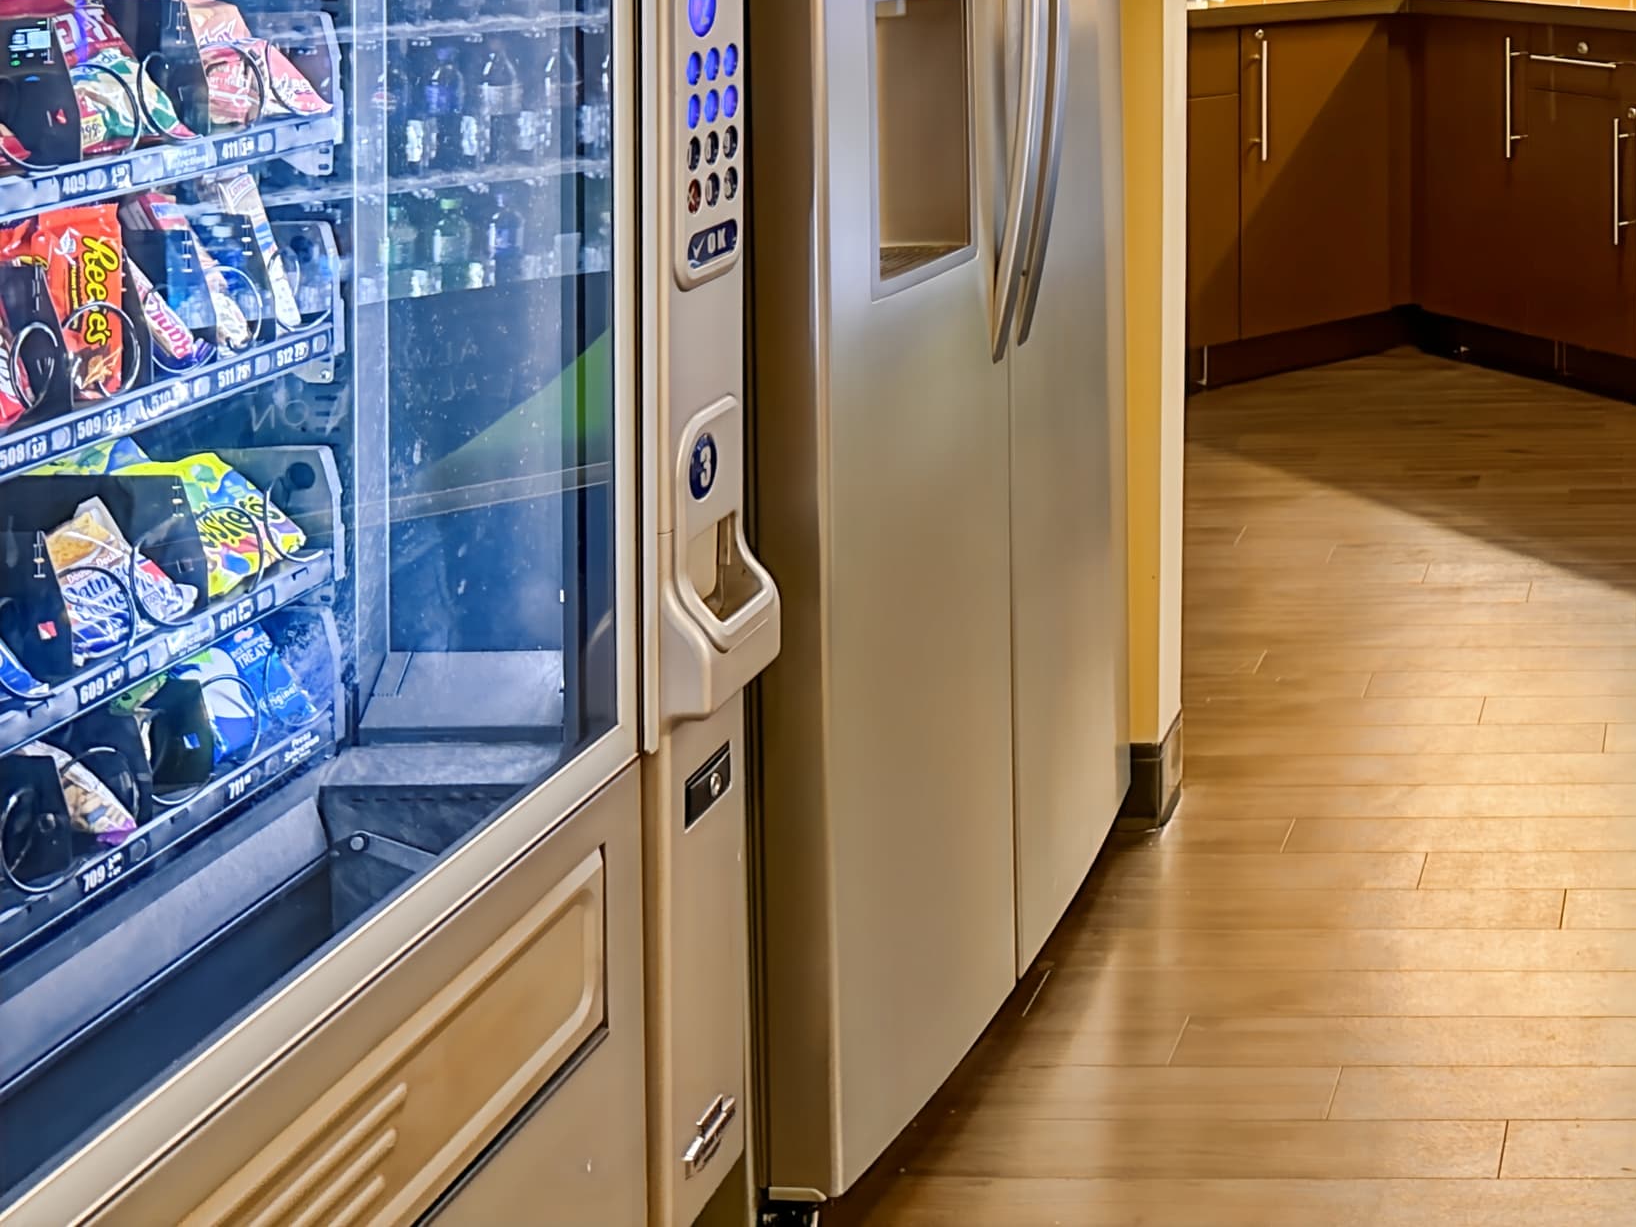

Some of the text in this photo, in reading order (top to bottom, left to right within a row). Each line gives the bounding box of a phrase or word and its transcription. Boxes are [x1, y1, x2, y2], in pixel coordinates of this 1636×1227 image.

[707, 227, 727, 255] OK
[699, 445, 713, 489] 3
[236, 641, 273, 669] TREATS
